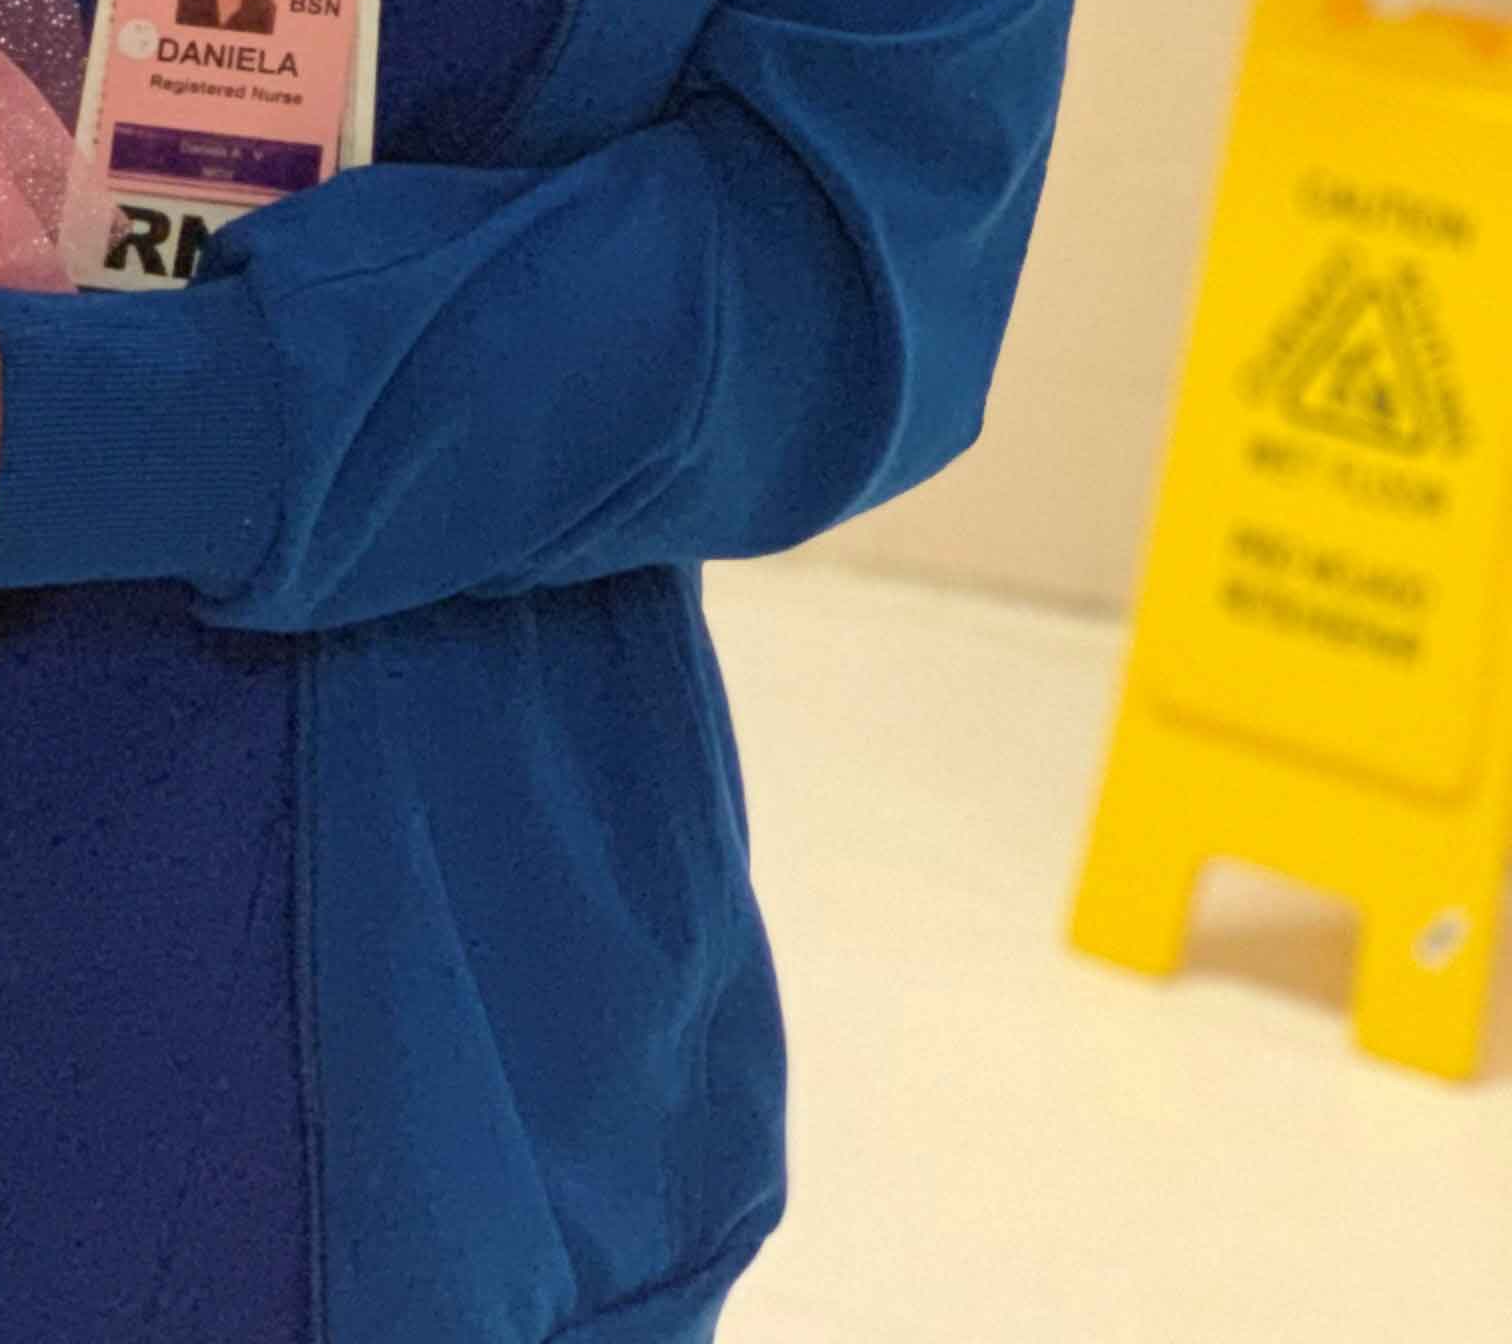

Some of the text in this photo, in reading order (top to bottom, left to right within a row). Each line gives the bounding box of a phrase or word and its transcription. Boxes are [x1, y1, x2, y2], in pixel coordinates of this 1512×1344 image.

[157, 37, 299, 78] DANIELA
[149, 73, 303, 106] Registered Nurse
